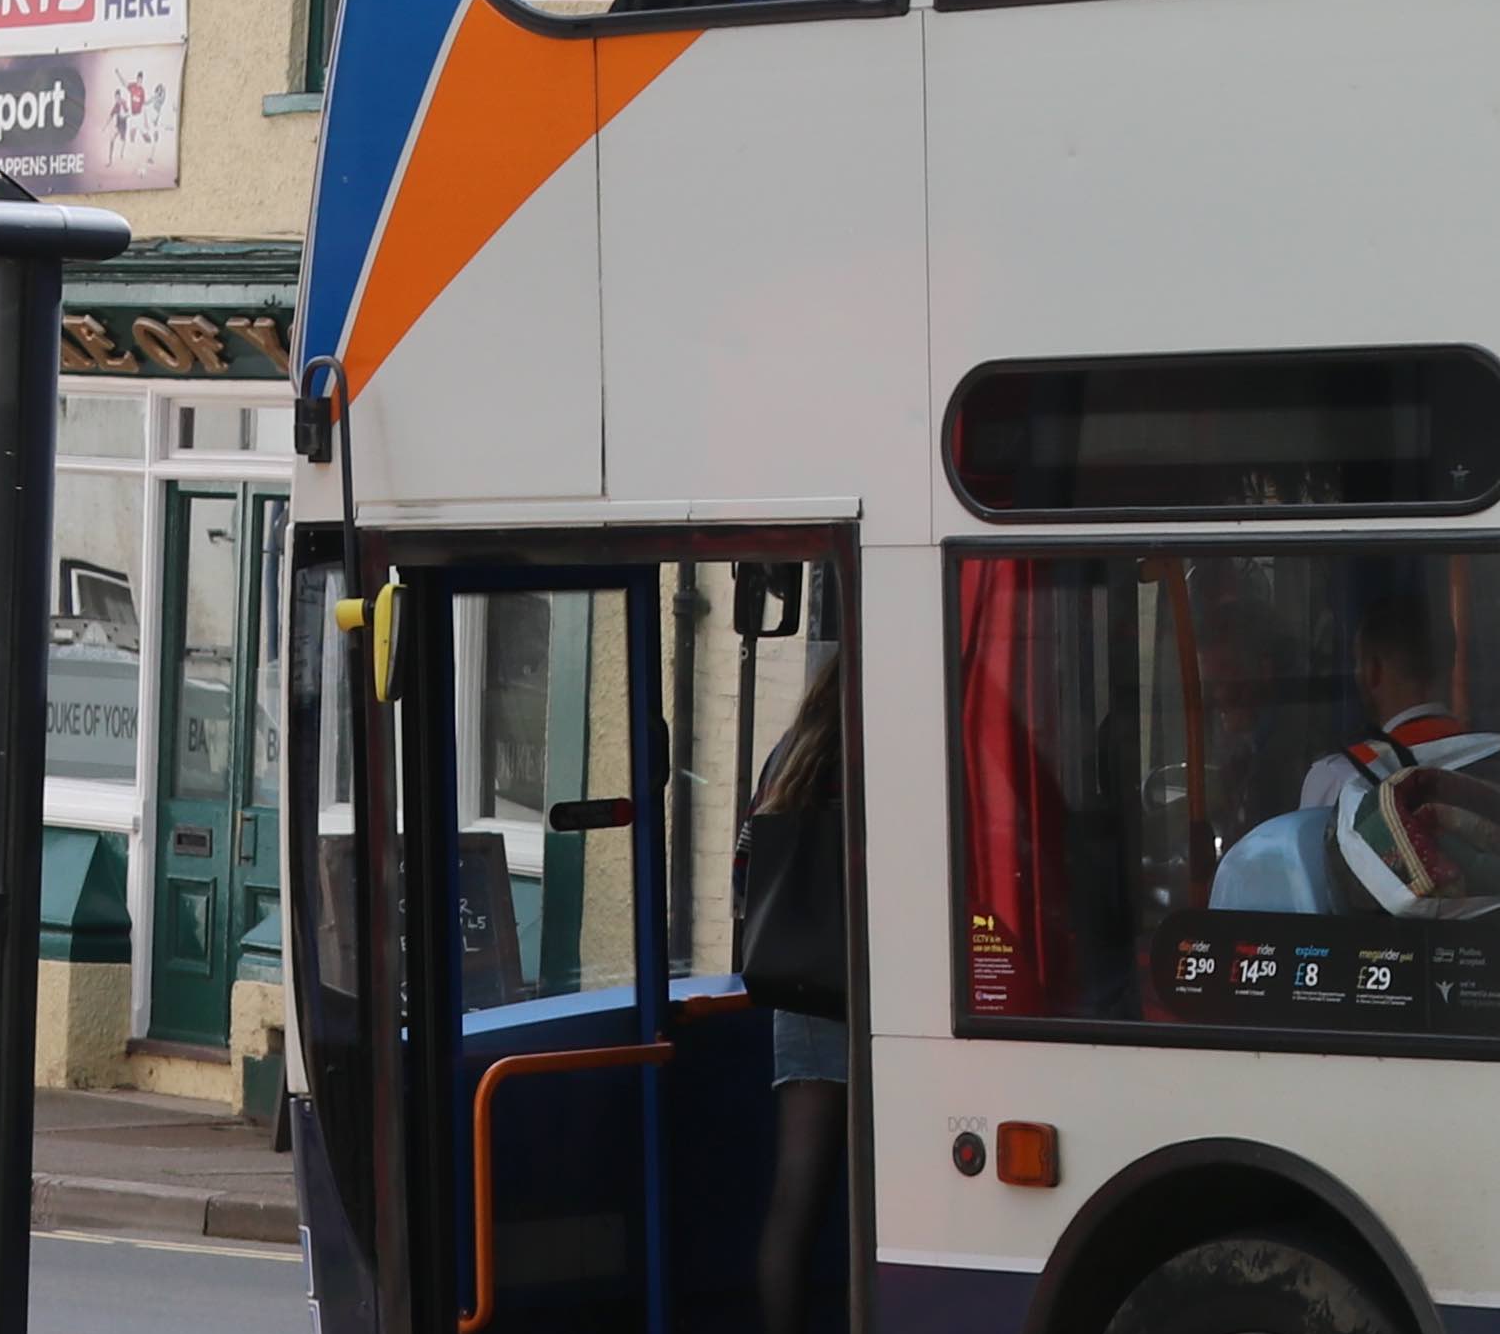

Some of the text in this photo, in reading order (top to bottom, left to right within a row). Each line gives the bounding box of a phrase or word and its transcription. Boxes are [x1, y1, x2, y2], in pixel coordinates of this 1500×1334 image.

[49, 153, 85, 174] HERE
[131, 315, 229, 373] OF
[46, 701, 138, 740] DUKE OF YORK
[1295, 945, 1330, 958] explorer
[1294, 962, 1319, 987] £8
[1356, 966, 1391, 990] £29
[947, 1116, 988, 1133] DOOR
